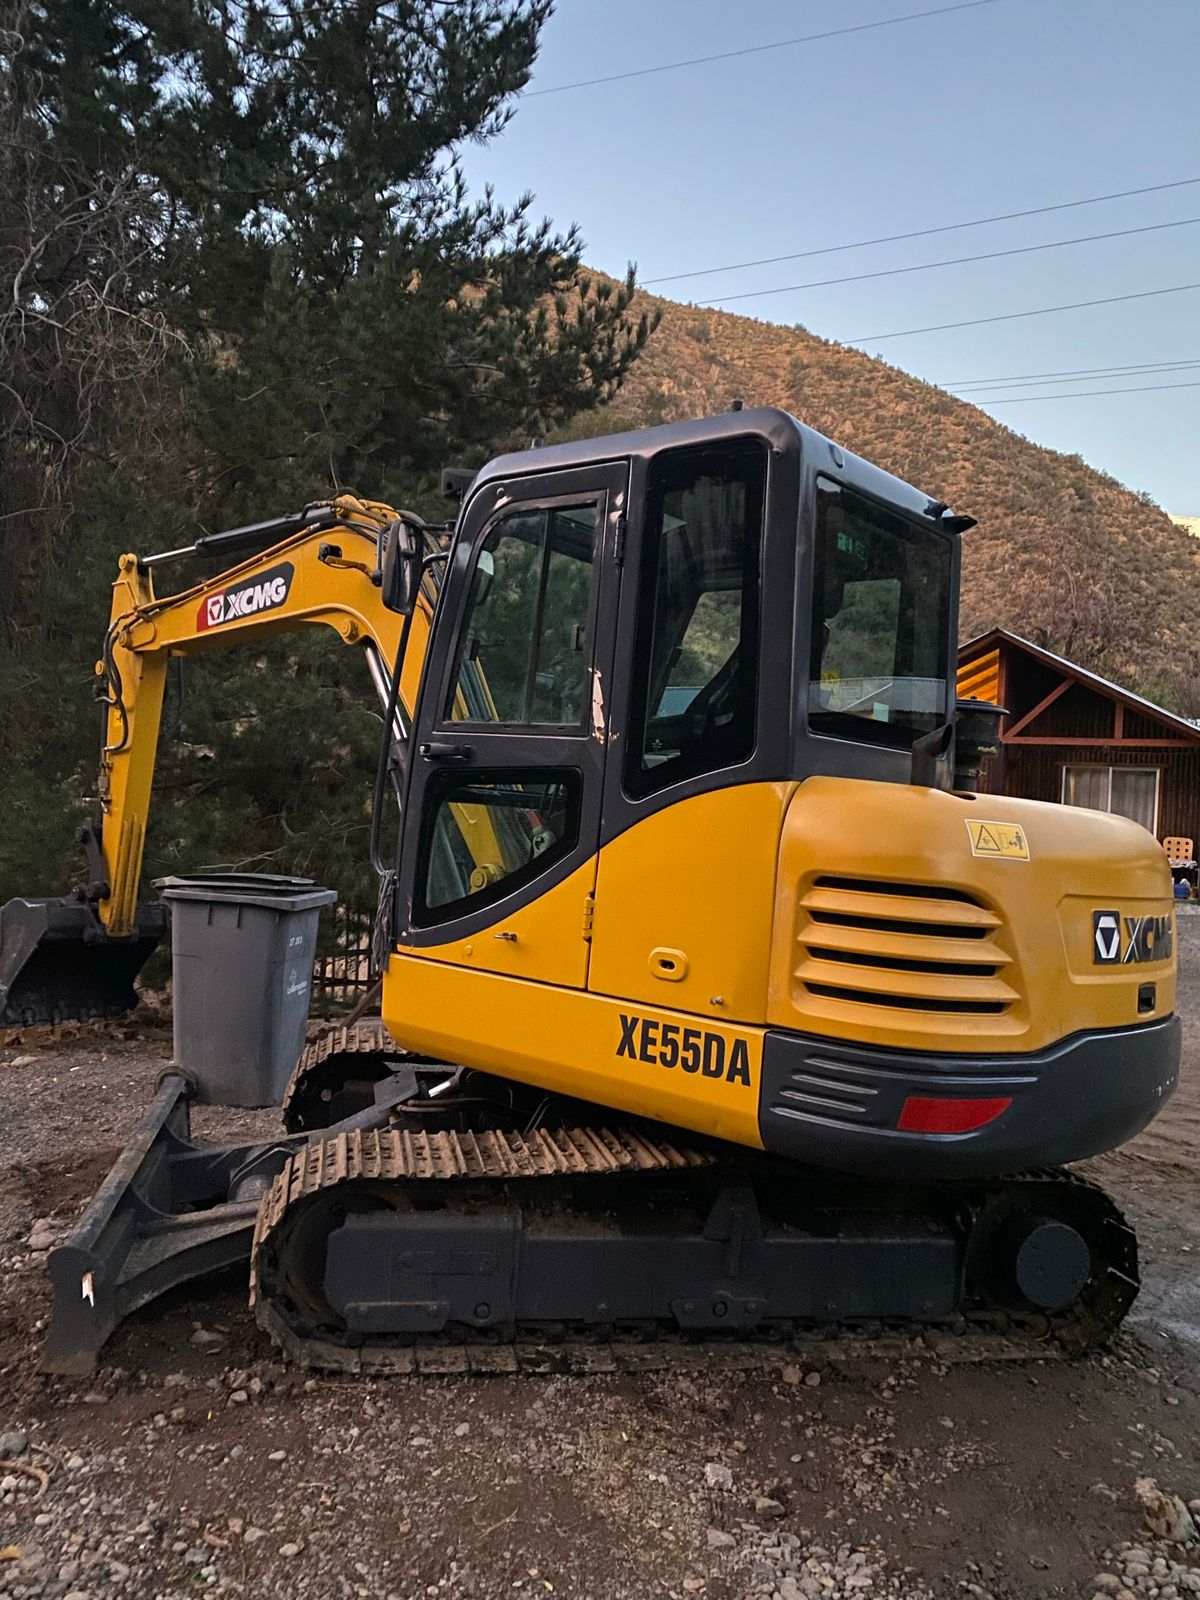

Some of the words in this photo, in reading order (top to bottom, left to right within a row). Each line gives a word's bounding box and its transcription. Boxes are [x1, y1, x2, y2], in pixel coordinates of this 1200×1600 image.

[225, 577, 287, 620] XCMG
[1121, 914, 1173, 964] XCM
[615, 1014, 751, 1087] XE55DA
